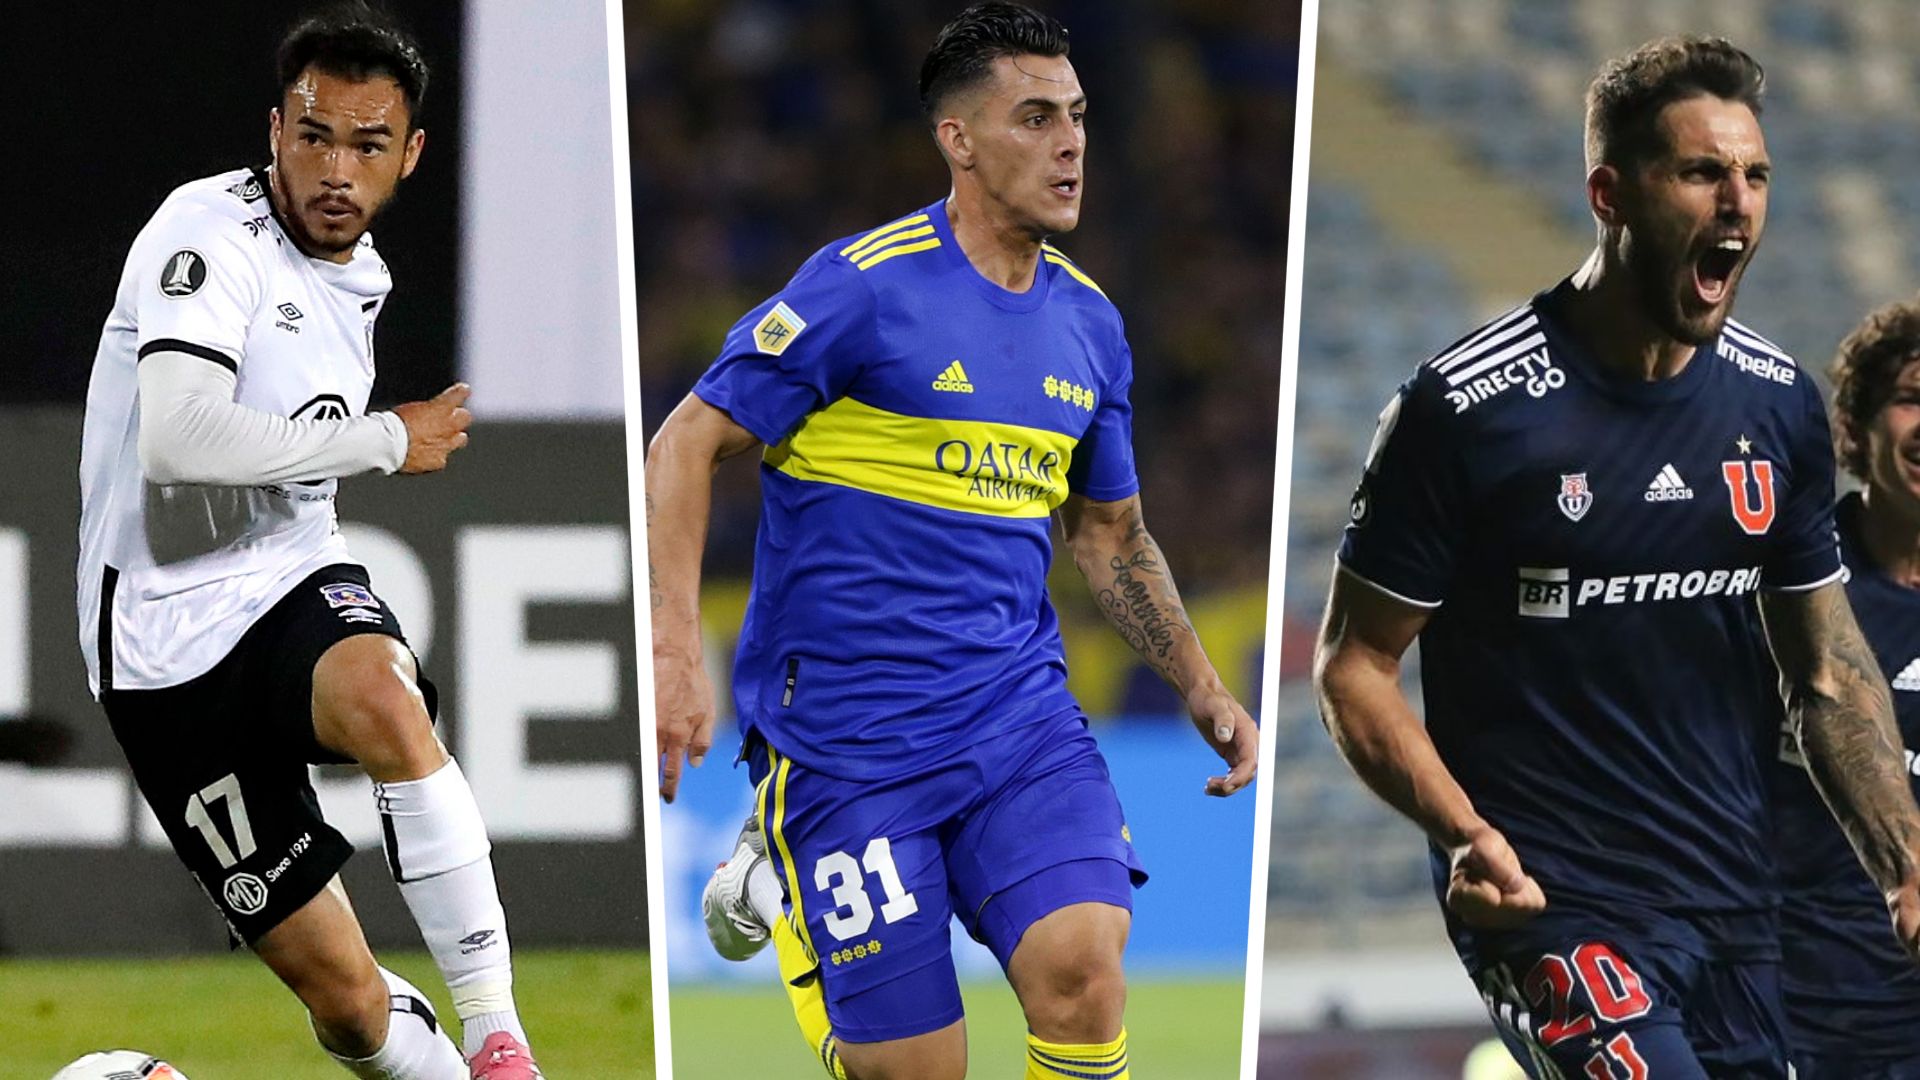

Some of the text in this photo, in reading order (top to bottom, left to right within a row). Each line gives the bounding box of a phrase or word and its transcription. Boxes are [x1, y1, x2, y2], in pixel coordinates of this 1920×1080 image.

[275, 320, 300, 334] umbro
[932, 380, 974, 394] adidas
[1444, 346, 1551, 414] DIRECTV
[1526, 367, 1566, 398] GO
[935, 440, 1059, 483] QATAR
[1644, 487, 1694, 502] adidas
[1721, 460, 1775, 535] U
[1524, 581, 1563, 605] BR
[1576, 565, 1762, 606] PETROBR
[184, 772, 258, 869] 17
[265, 832, 312, 882] Since 1924
[227, 876, 265, 911] MG
[814, 837, 919, 941] 31
[1524, 940, 1653, 1048] 20
